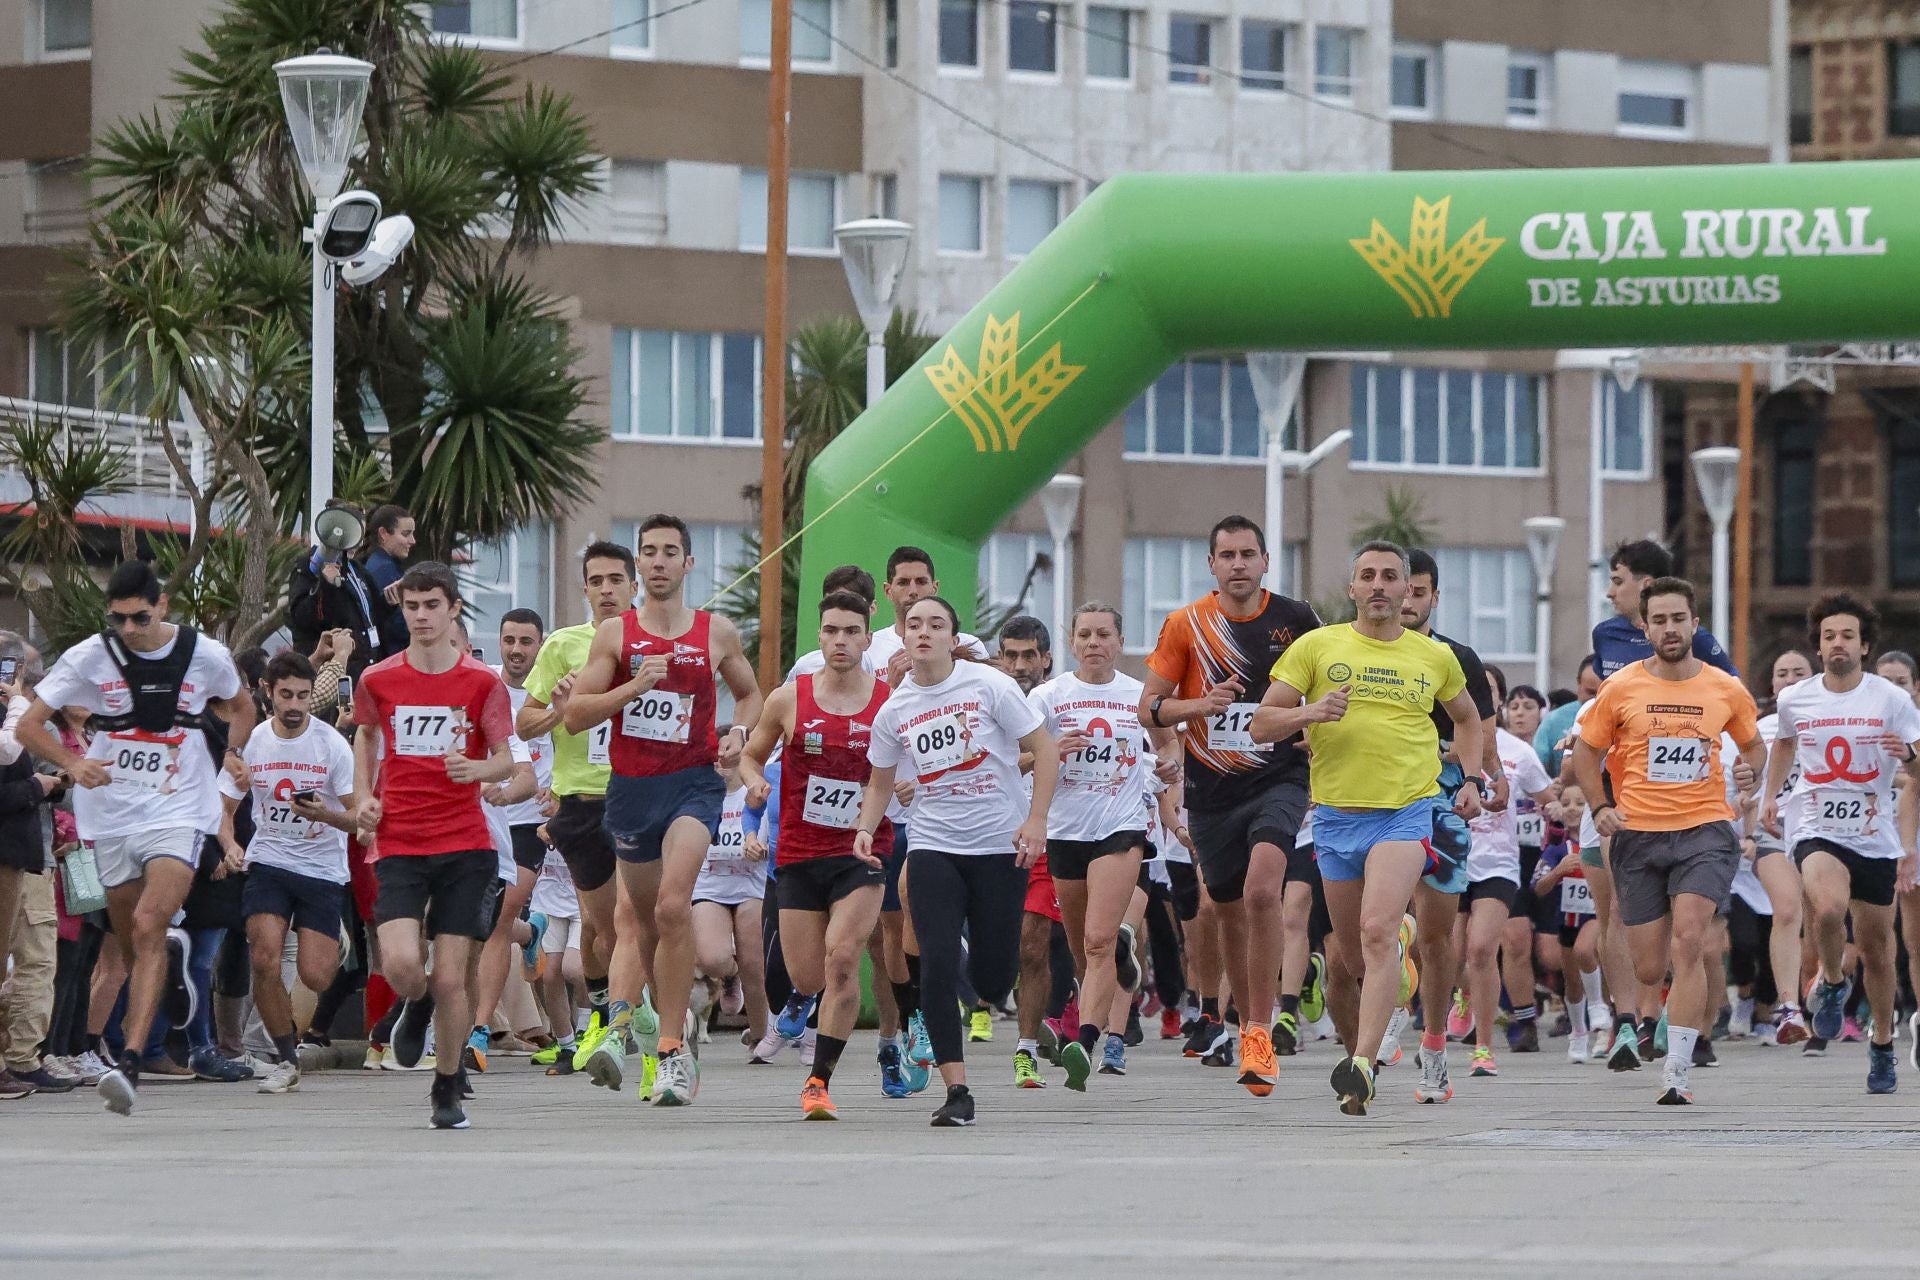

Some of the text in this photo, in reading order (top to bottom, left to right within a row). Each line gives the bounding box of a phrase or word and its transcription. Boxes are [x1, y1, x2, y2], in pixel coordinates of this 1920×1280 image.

[1520, 207, 1886, 263] CAJA RURAL
[1528, 275, 1782, 307] DE ASTURIAS
[1362, 675, 1405, 686] DISCIPLINAS
[1368, 667, 1398, 677] DEPORTE
[629, 697, 673, 721] 209
[1054, 703, 1071, 714] XXIV
[1072, 700, 1106, 710] CARRERA
[403, 715, 447, 736] 177
[909, 708, 942, 728] CARRERA
[1811, 718, 1844, 728] CARRERA
[1846, 717, 1884, 728] ANTI-SIDA
[917, 725, 956, 754] 089
[118, 749, 161, 772] 068
[1653, 746, 1696, 765] 244
[263, 762, 293, 770] CARRERA
[294, 763, 328, 774] ANTI-SIDA
[811, 786, 856, 809] 247
[1823, 801, 1861, 819] 262
